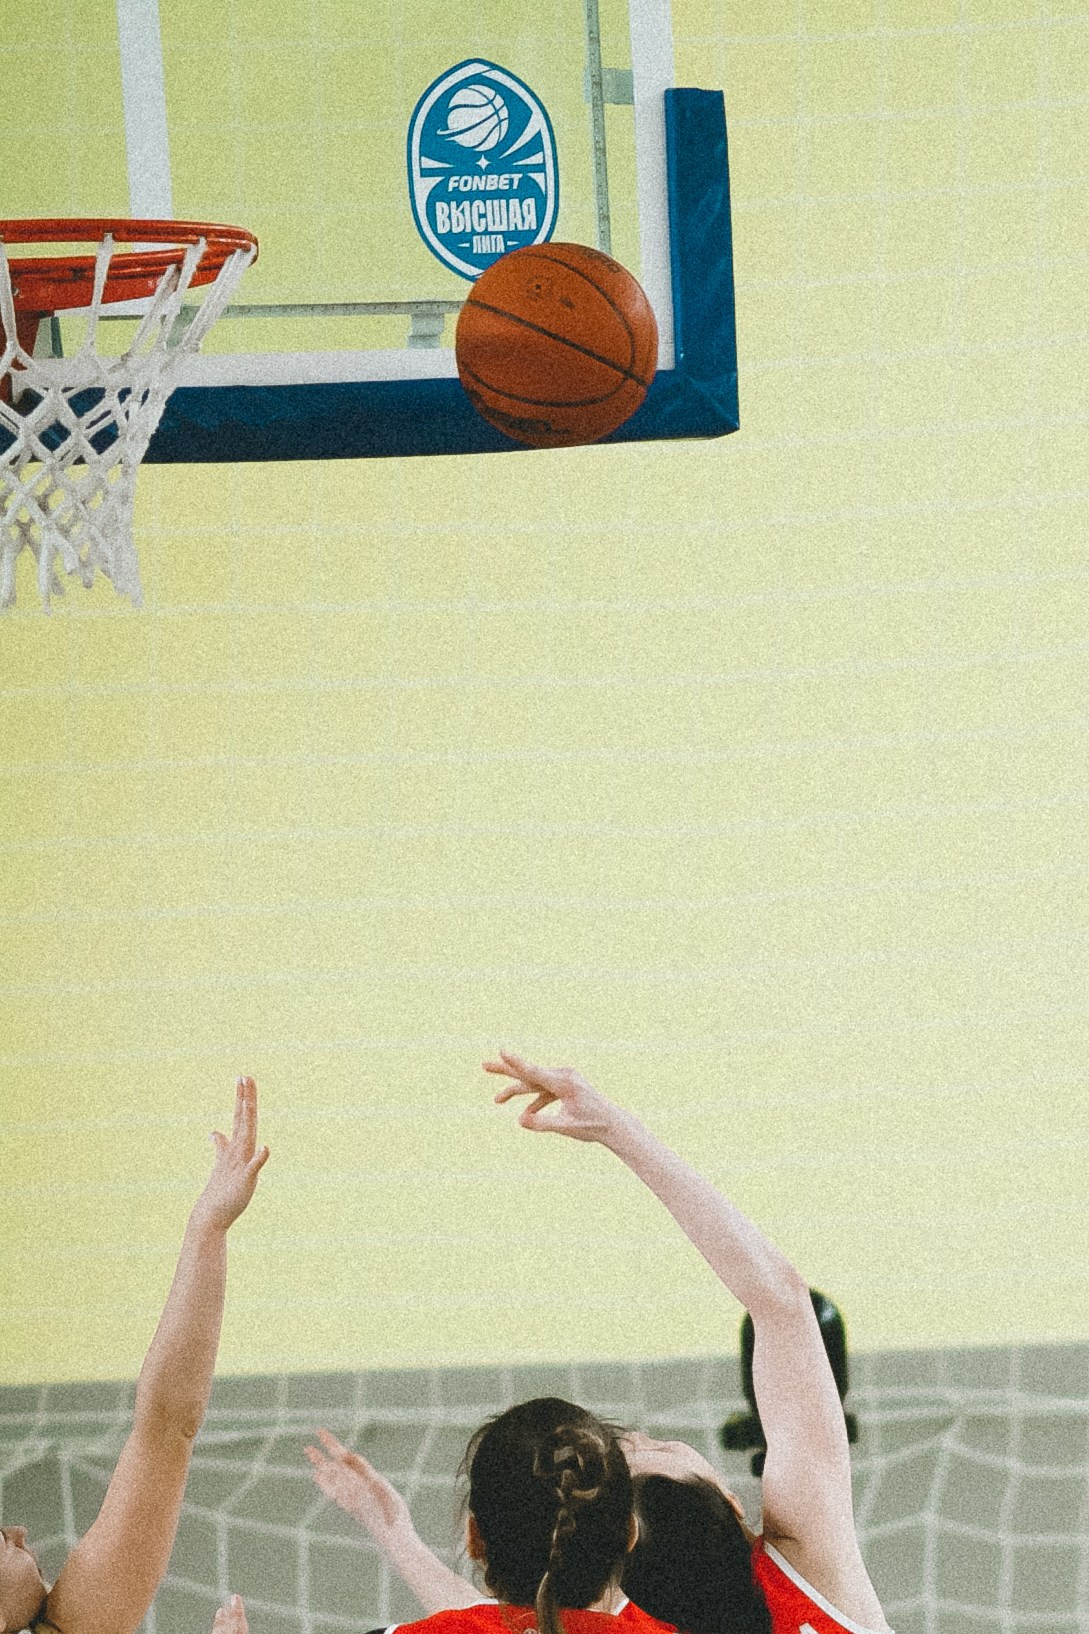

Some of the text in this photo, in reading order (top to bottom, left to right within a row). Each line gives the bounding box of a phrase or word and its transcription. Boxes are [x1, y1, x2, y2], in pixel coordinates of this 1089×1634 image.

[448, 173, 523, 192] FONBET
[435, 198, 537, 234] ВЫСШАЯ
[473, 234, 505, 254] ЛИГА
